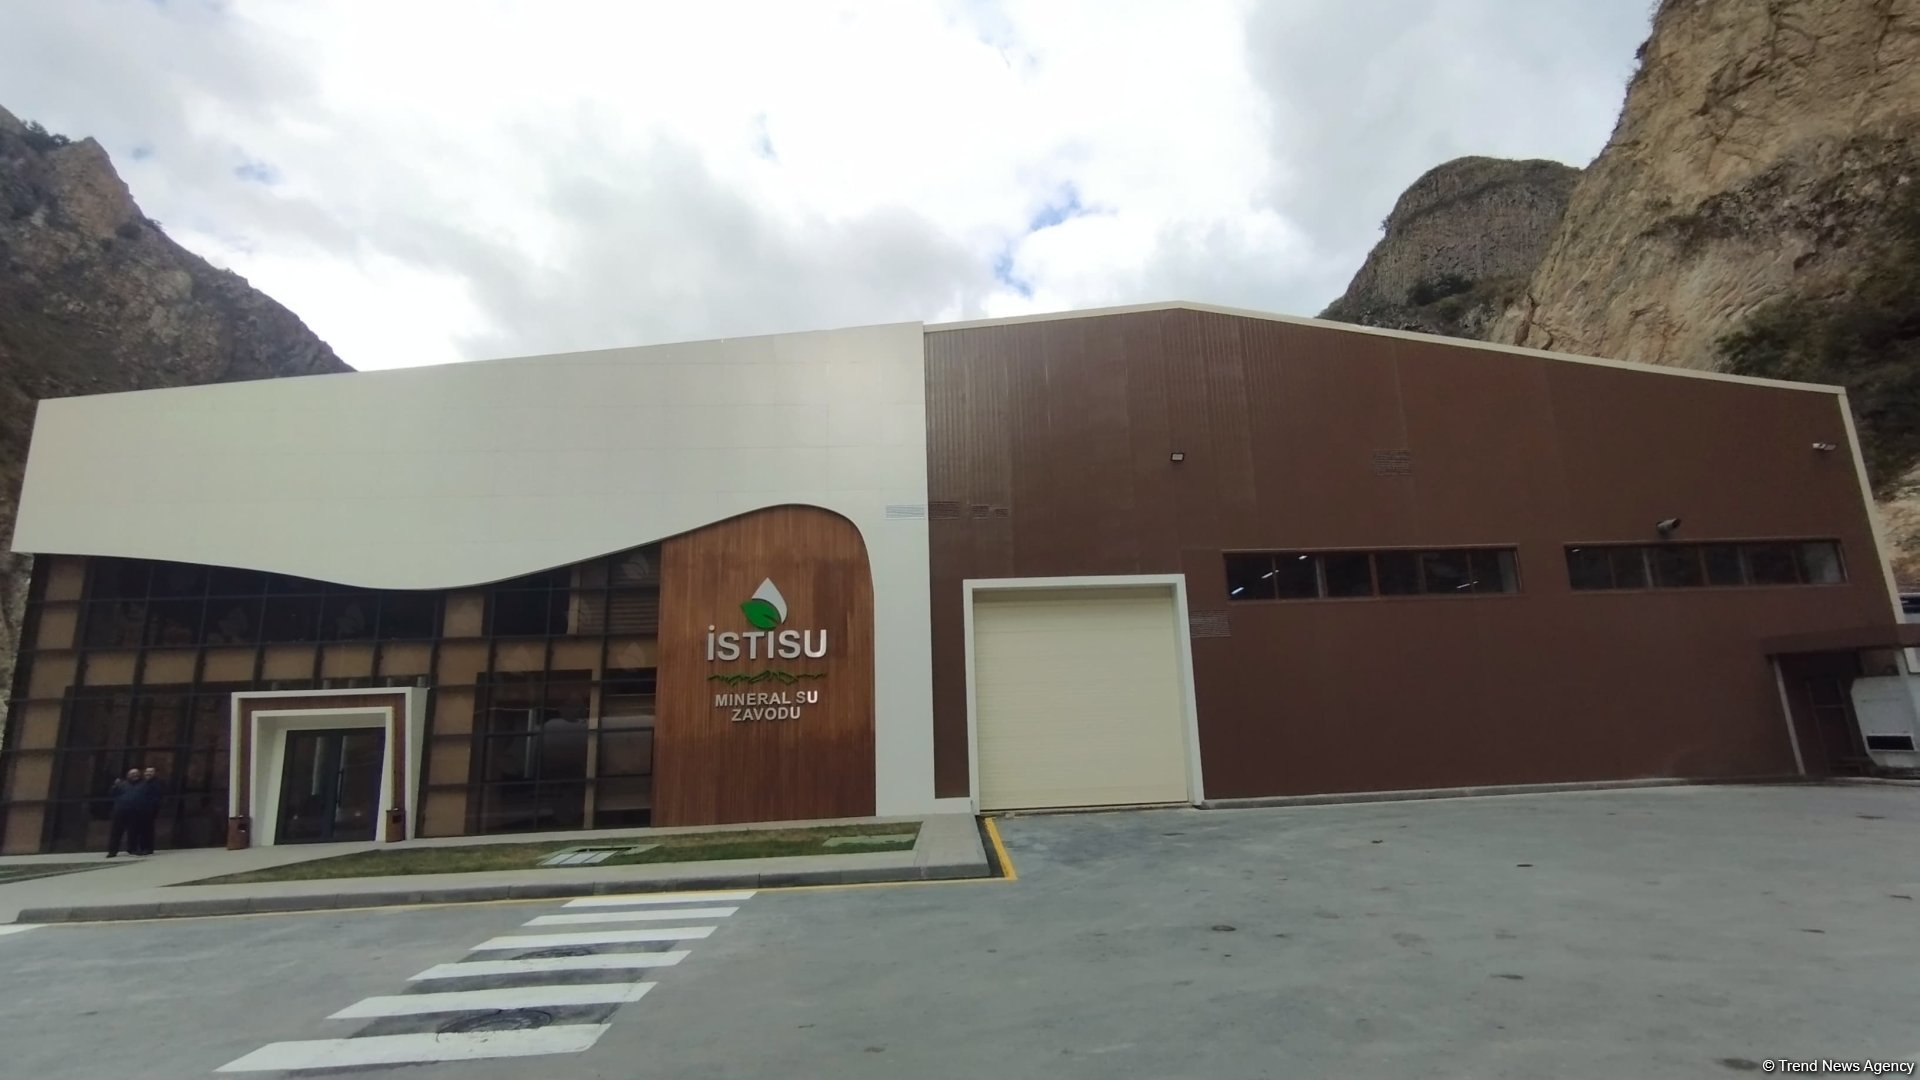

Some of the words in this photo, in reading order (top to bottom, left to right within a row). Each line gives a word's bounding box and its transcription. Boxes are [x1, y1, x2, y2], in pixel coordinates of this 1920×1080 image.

[715, 692, 791, 707] MINERAL
[796, 690, 818, 704] SU
[731, 706, 801, 721] ZAVODU
